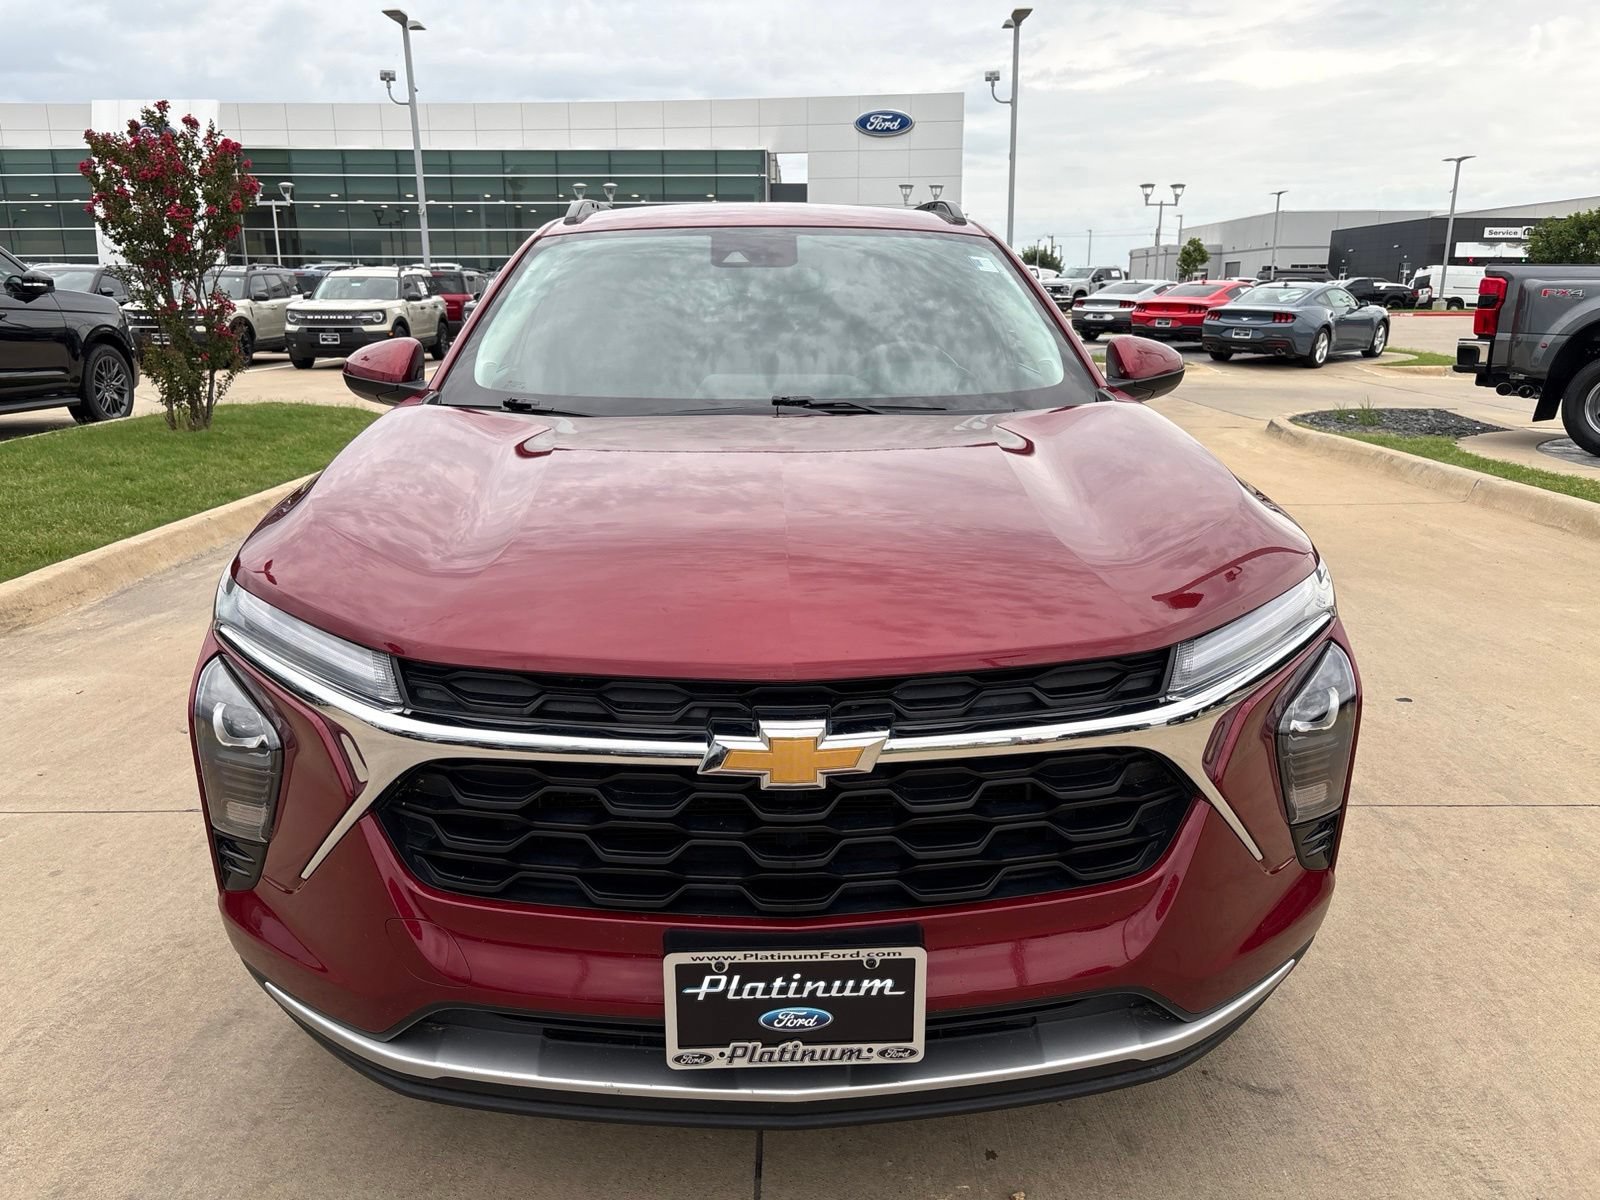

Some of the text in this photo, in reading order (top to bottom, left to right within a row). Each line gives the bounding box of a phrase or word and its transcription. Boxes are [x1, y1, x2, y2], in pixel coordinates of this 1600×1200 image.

[866, 114, 901, 130] Ford
[1541, 288, 1584, 298] FX4
[691, 950, 902, 961] www.PlatinumFord.com
[682, 973, 906, 1001] Platinum
[773, 1011, 818, 1028] Ford
[680, 1043, 911, 1065] Ford Platinum Ford
